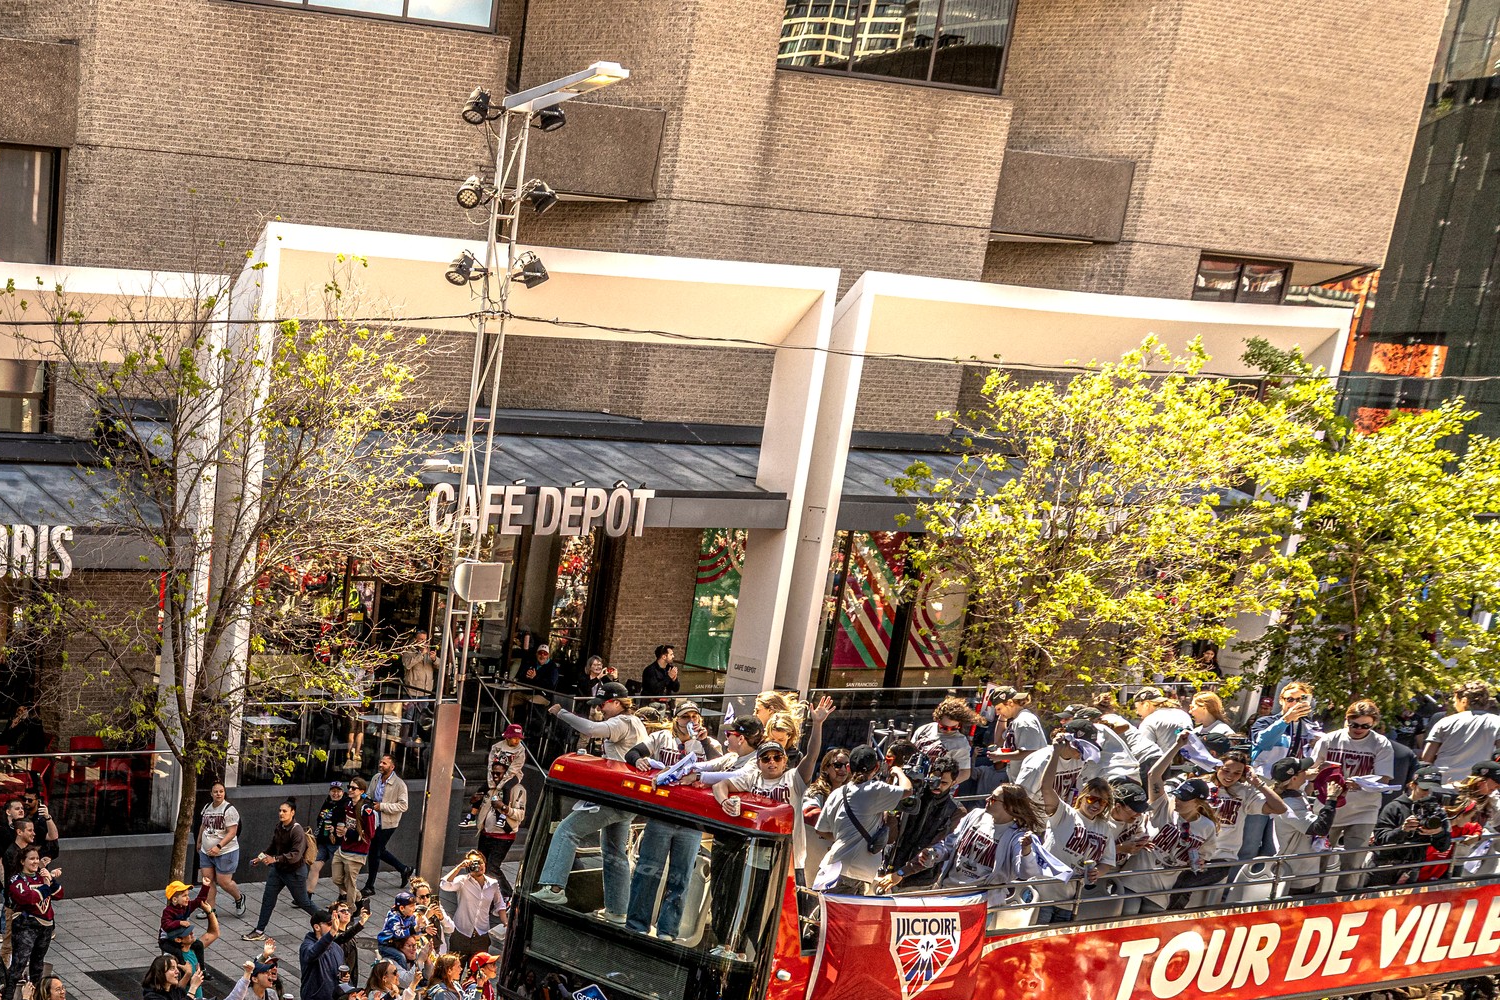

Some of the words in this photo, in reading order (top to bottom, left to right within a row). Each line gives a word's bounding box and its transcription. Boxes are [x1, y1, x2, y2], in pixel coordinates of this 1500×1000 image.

[428, 478, 527, 535] CAFÉ
[534, 479, 656, 538] DÉPÔT
[15, 882, 26, 894] 7
[896, 918, 958, 945] VICTOIRE
[1284, 911, 1368, 982] DE
